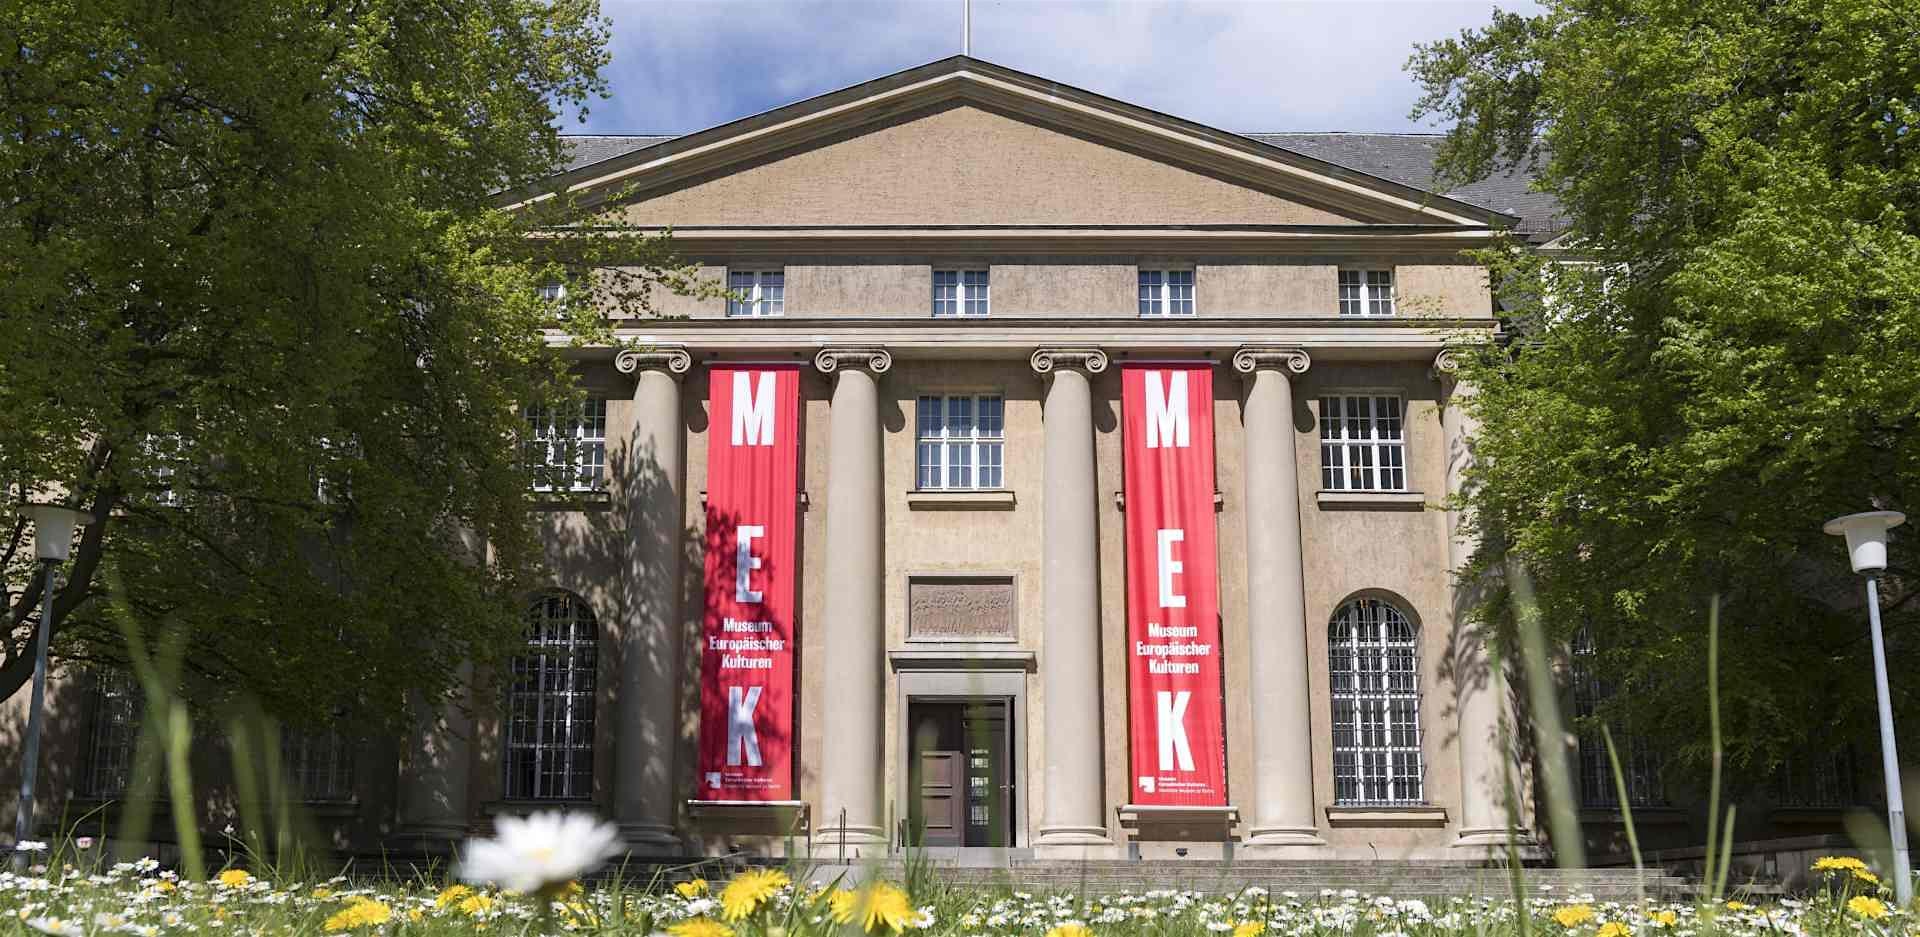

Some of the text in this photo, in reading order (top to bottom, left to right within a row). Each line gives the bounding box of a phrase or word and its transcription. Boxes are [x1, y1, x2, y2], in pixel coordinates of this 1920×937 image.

[732, 371, 776, 446] M
[1145, 370, 1190, 448] M
[735, 525, 764, 603] E
[1157, 528, 1187, 608] E
[709, 635, 785, 653] Europäischer
[723, 617, 772, 632] Museum
[1148, 623, 1197, 637] Museum
[722, 653, 772, 669] Kulturen
[1136, 641, 1211, 658] Europäischer
[1149, 659, 1199, 674] Kulturen
[727, 686, 763, 767] K
[1157, 691, 1195, 772] K
